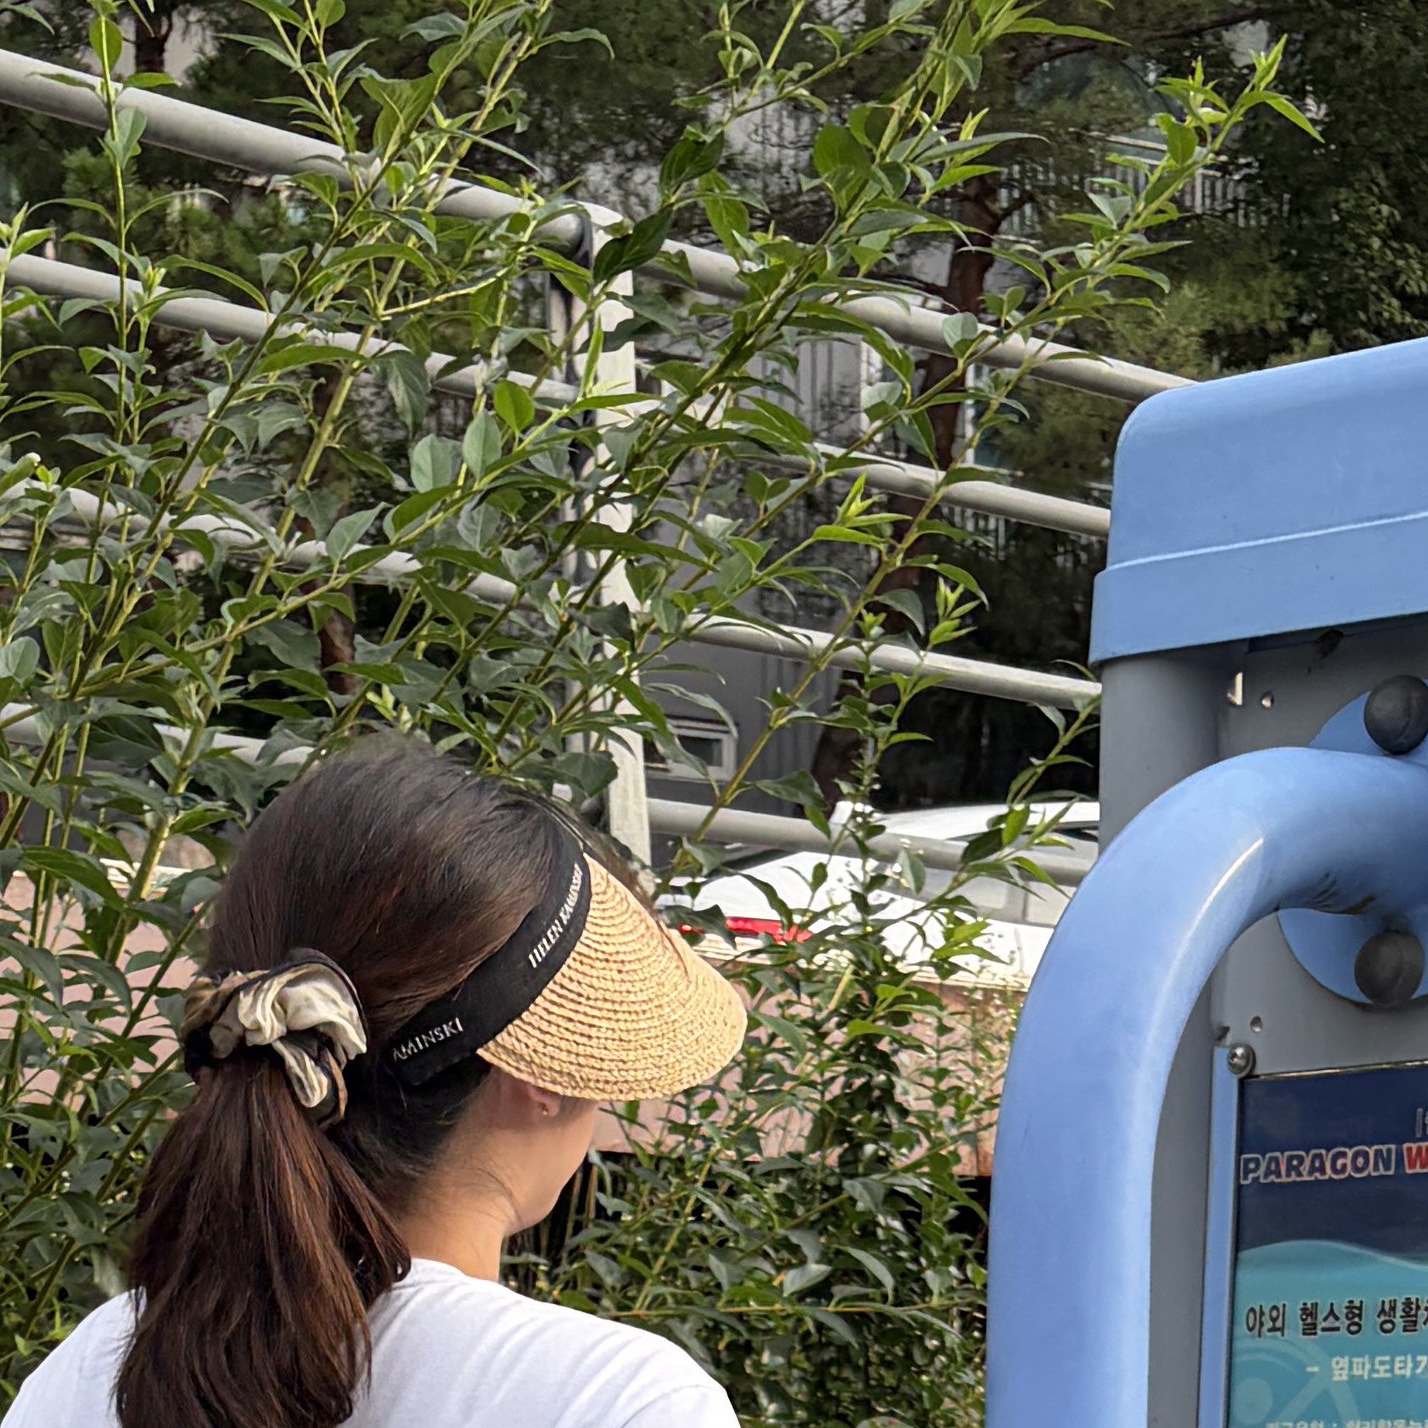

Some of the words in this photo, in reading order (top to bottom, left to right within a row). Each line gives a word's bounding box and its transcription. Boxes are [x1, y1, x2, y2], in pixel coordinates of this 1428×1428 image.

[528, 917, 565, 969] HELEN
[1240, 1145, 1397, 1184] PARAGON
[1245, 1303, 1287, 1338] 야외
[1298, 1300, 1364, 1337] 헬스형
